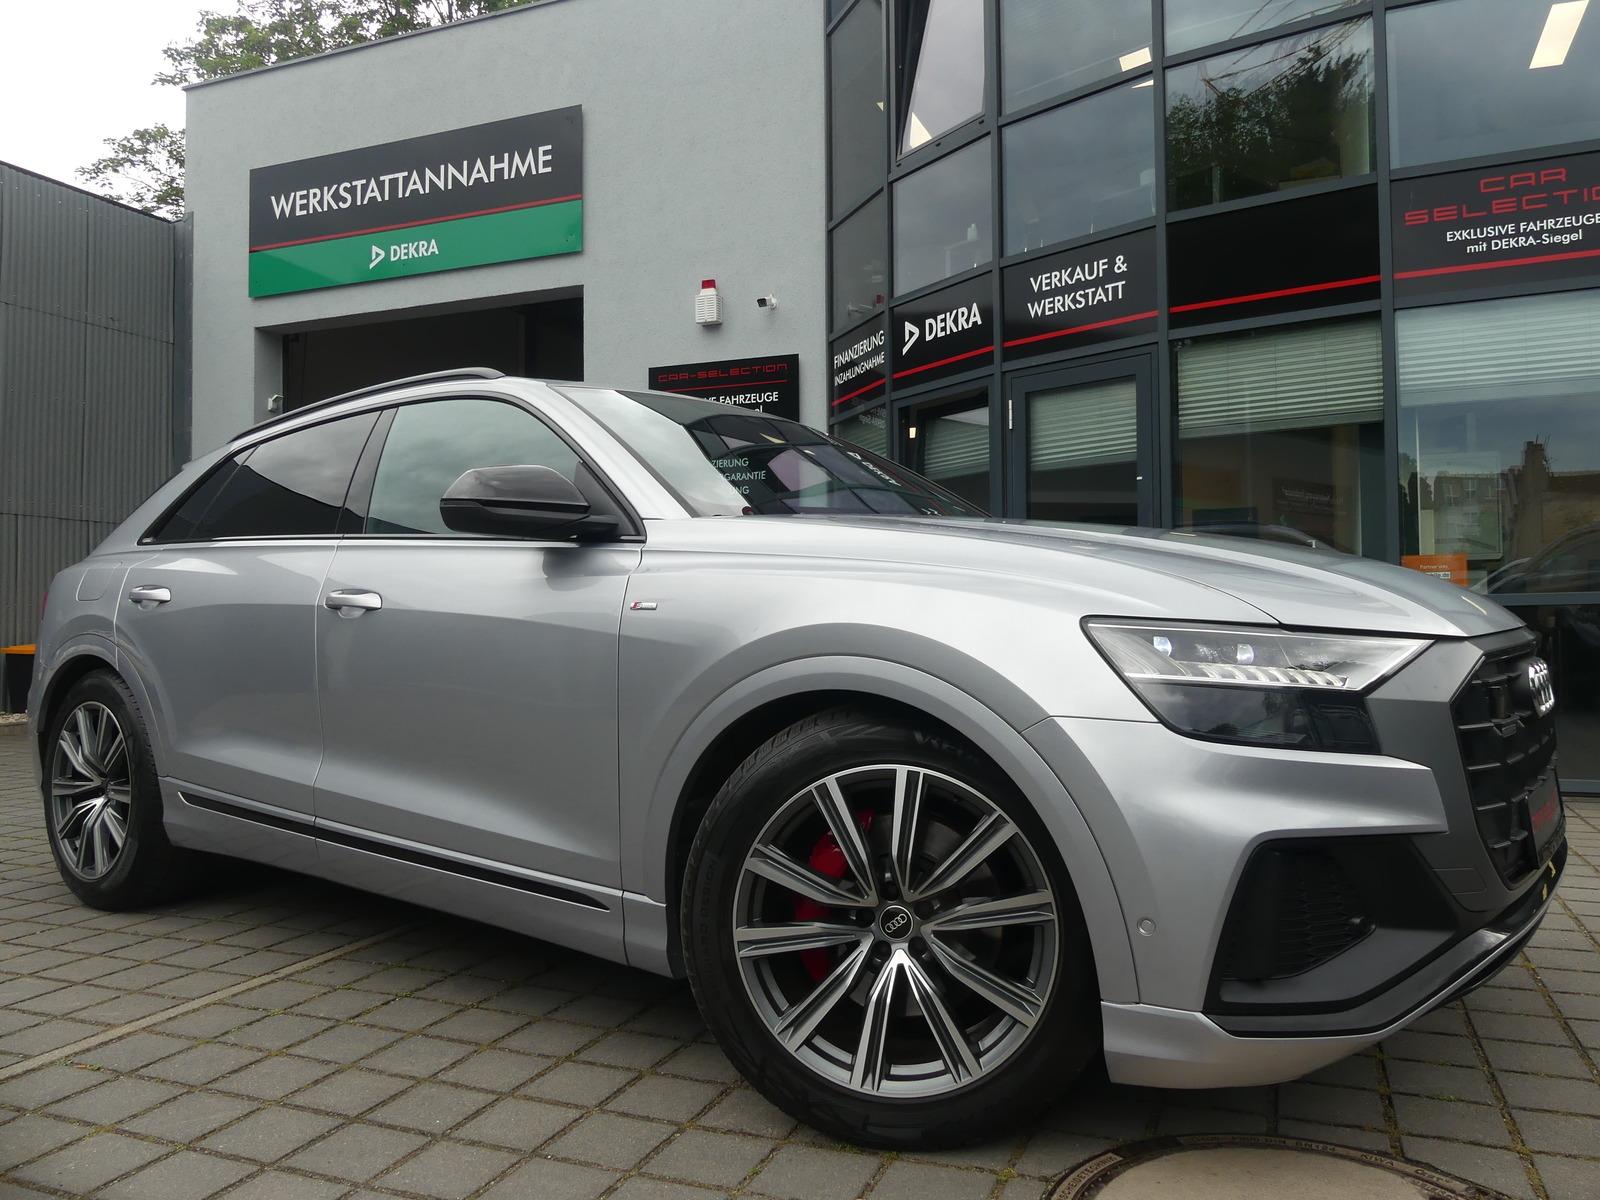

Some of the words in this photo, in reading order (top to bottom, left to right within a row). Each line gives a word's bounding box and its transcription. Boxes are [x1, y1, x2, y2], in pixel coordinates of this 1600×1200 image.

[271, 145, 552, 220] WERKSTATTANNAHME
[1479, 167, 1567, 193] CAR
[1446, 223, 1516, 242] EXKLUSIVE
[1466, 241, 1487, 254] mit
[1491, 229, 1582, 251] DEKRA-Siegel
[391, 239, 439, 261] DEKRA
[1030, 258, 1108, 293] VERKAUF
[1114, 255, 1128, 273] &
[1027, 281, 1126, 319] WERKSTATT
[925, 302, 982, 342] DEKRA
[833, 330, 885, 369] FINANZIERUNG
[719, 391, 779, 405] FAHRZEUGE
[711, 457, 749, 468] ZIERUNG
